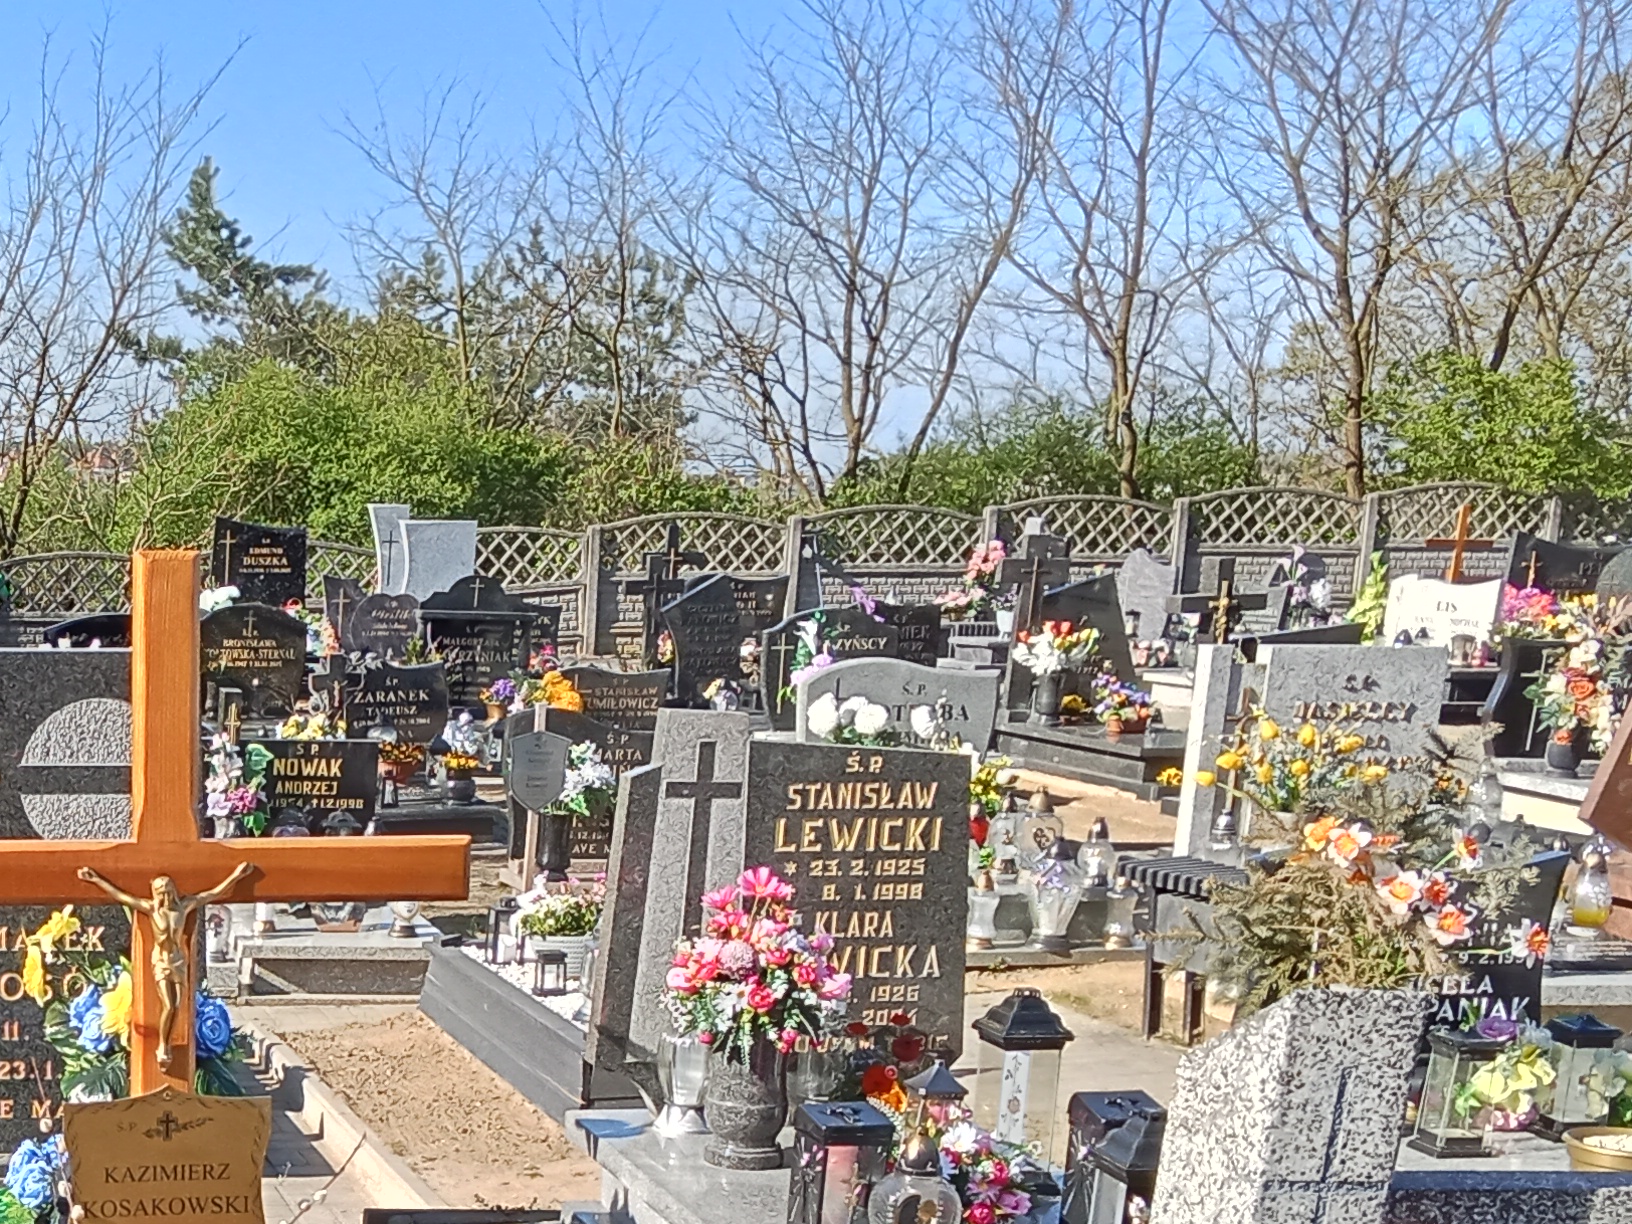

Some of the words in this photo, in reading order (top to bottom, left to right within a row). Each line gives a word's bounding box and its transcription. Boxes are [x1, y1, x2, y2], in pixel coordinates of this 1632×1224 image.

[242, 557, 288, 567] DUSZKA
[354, 689, 430, 703] ZARANEK
[595, 686, 658, 696] STANISŁAW
[272, 758, 344, 778] NOWAK
[274, 780, 339, 796] ANDRZEJ
[786, 781, 939, 810] STANISŁAW
[773, 816, 944, 853] LEWICKI
[874, 856, 927, 877] 1925
[872, 882, 924, 901] 1998
[814, 910, 894, 938] KLARA
[831, 944, 941, 979] WICKA
[870, 984, 921, 1004] 1926
[104, 1163, 231, 1184] KAZIMIERZ
[82, 1195, 250, 1219] KOSAKOWSKI
